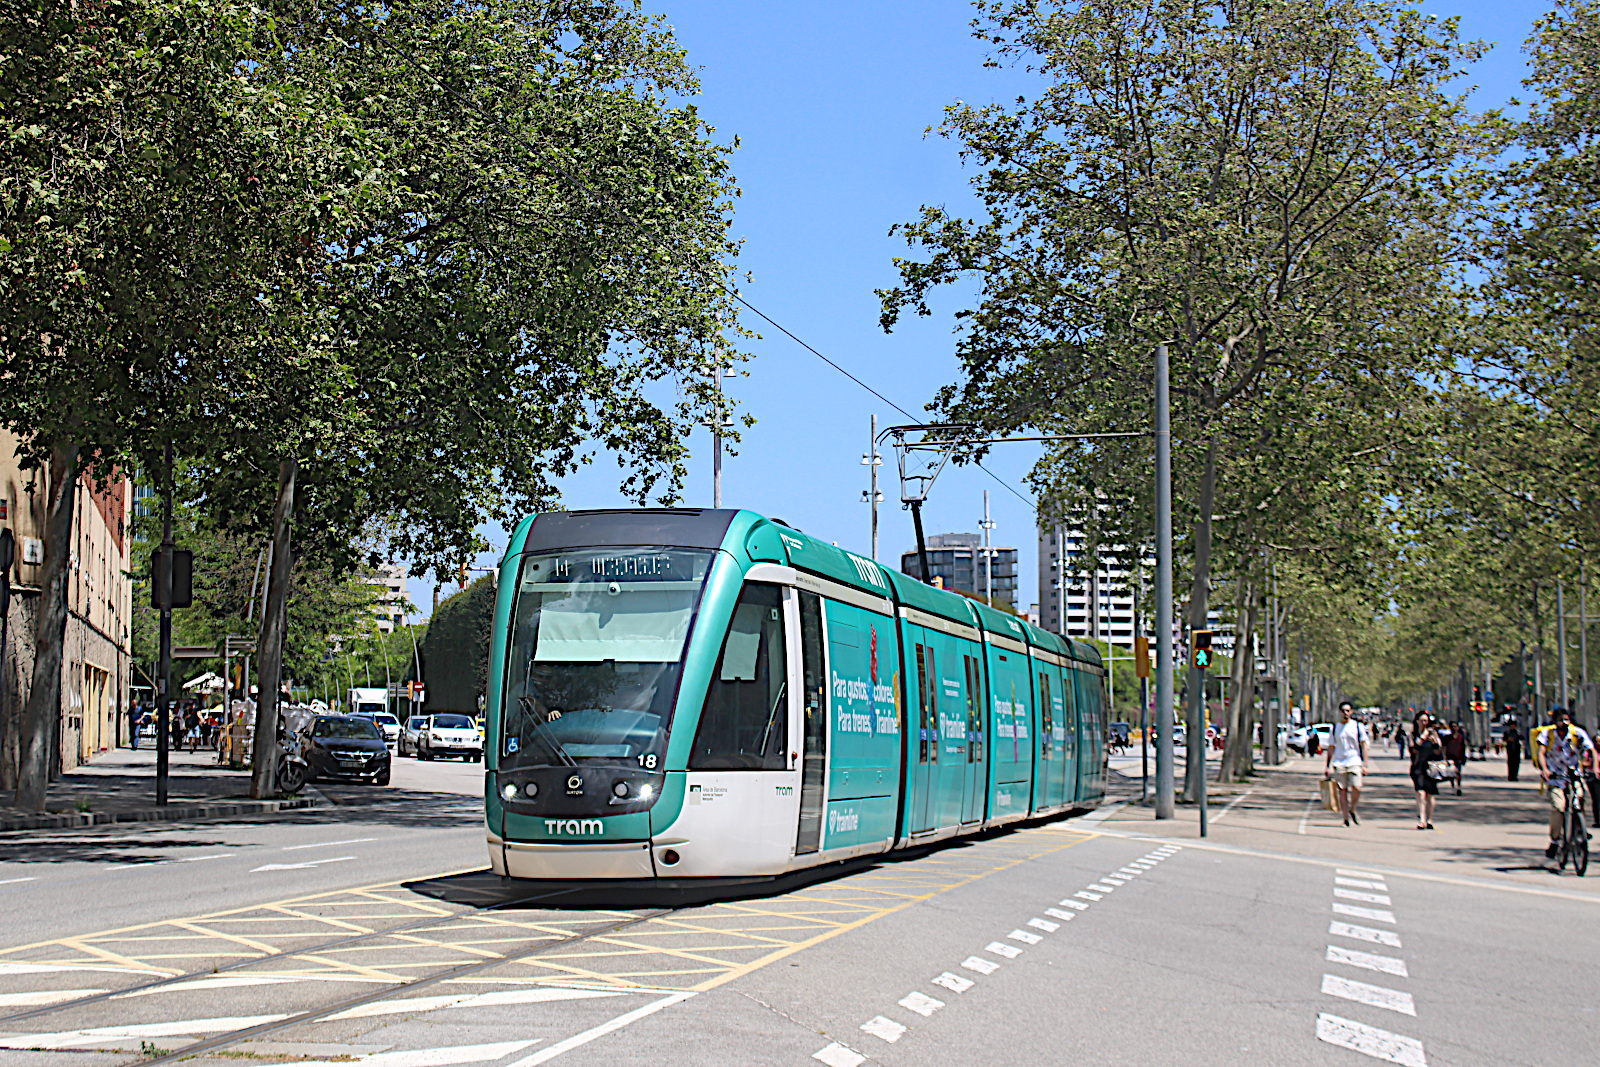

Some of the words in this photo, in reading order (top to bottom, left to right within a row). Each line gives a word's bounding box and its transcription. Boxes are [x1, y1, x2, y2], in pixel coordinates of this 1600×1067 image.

[833, 670, 847, 698] Para
[847, 677, 869, 706] gustos,
[873, 677, 895, 704] colores.
[837, 704, 852, 732] Para
[852, 709, 872, 738] trenes,
[945, 712, 966, 739] trainline
[637, 754, 657, 769] 18
[836, 808, 858, 833] trainline
